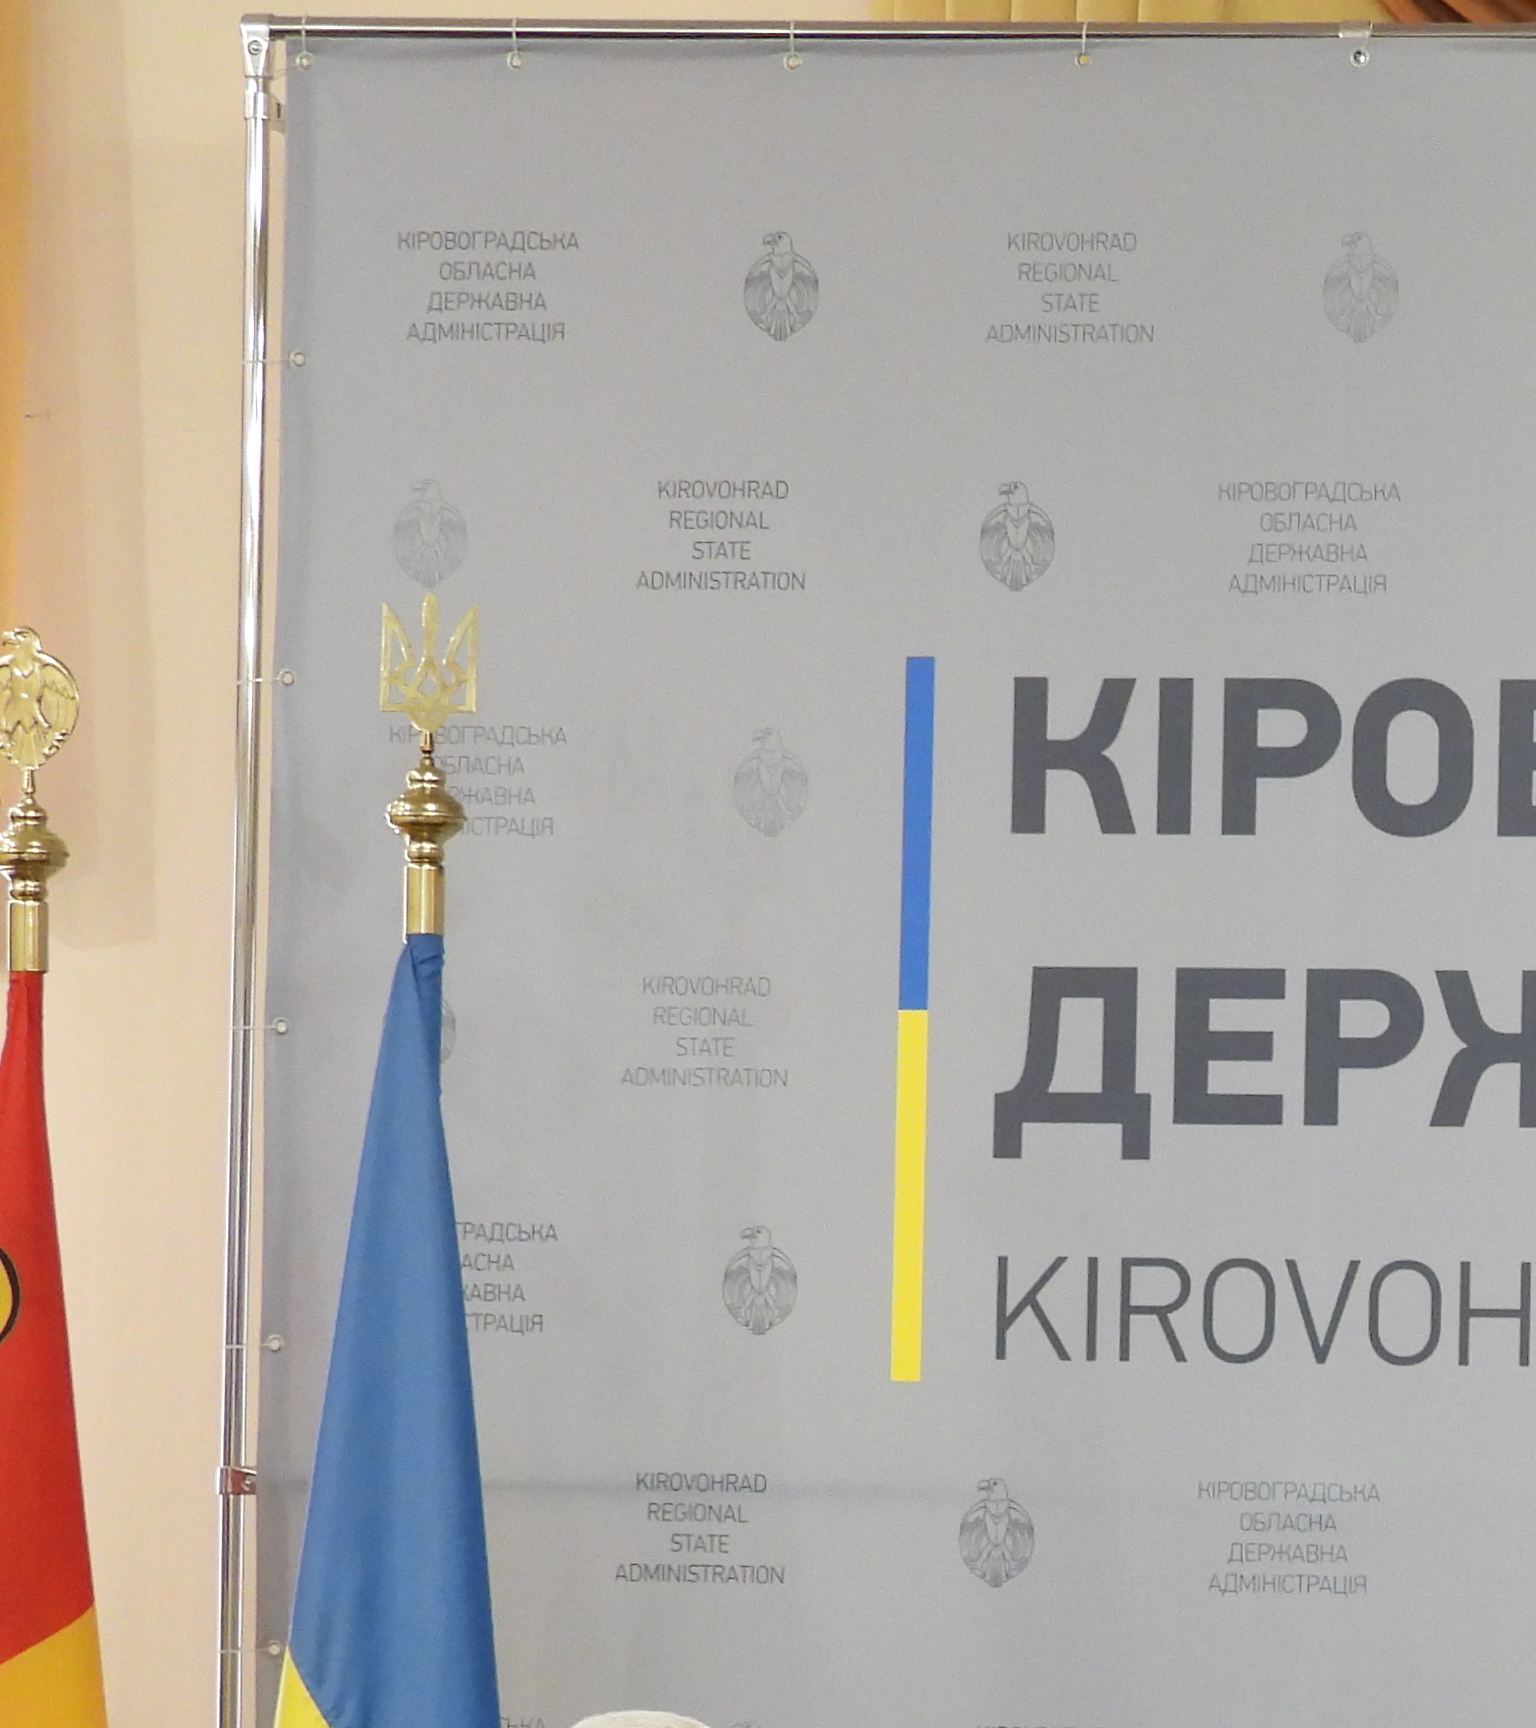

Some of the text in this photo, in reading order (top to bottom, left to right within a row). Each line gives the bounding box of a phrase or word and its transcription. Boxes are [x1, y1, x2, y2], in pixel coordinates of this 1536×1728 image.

[397, 230, 580, 253] КІРОВОГРАДСЬКА
[1007, 231, 1138, 253] KIROVOHRAD
[438, 260, 537, 282] ОБЛАСНА
[1018, 261, 1118, 283] REGIONAL
[426, 291, 547, 314] ДЕРЖАВНА
[1041, 292, 1099, 313] STATE
[406, 321, 566, 344] АДМІНІСТРАЦІЯ
[985, 322, 1155, 344] ADMINISTRATION
[657, 479, 790, 500] KIROVOHRAD
[1218, 481, 1402, 504] КІРОВОГРАДСЬКА
[668, 509, 770, 531] REGIONAL
[1259, 512, 1358, 533] ОБЛАСНА
[691, 540, 751, 561] STATE
[1247, 542, 1368, 565] ДЕРЖАВНА
[635, 570, 806, 592] ADMINISTRATION
[1228, 573, 1387, 597] АДМІНІСТРАЦІЯ
[389, 725, 567, 747] КІРВОГРАДСЬКА
[642, 975, 771, 998] KIROVOHRAD
[652, 1006, 753, 1027] REGIONAL
[676, 1036, 735, 1057] STATE
[621, 1066, 788, 1088] ADMINISTRATION
[636, 1472, 768, 1493] KIROVOHRAD
[1198, 1480, 1381, 1505] КІРОВОГРАДСЬКА
[647, 1502, 749, 1524] REGIONAL
[1239, 1511, 1338, 1533] ОБЛАСНА
[670, 1532, 730, 1554] STATE
[1226, 1541, 1349, 1565] ДЕРЖАВНА
[614, 1562, 786, 1585] ADMINISTRATION
[1208, 1572, 1368, 1597] АДМІНІСТРАЦІЯ
